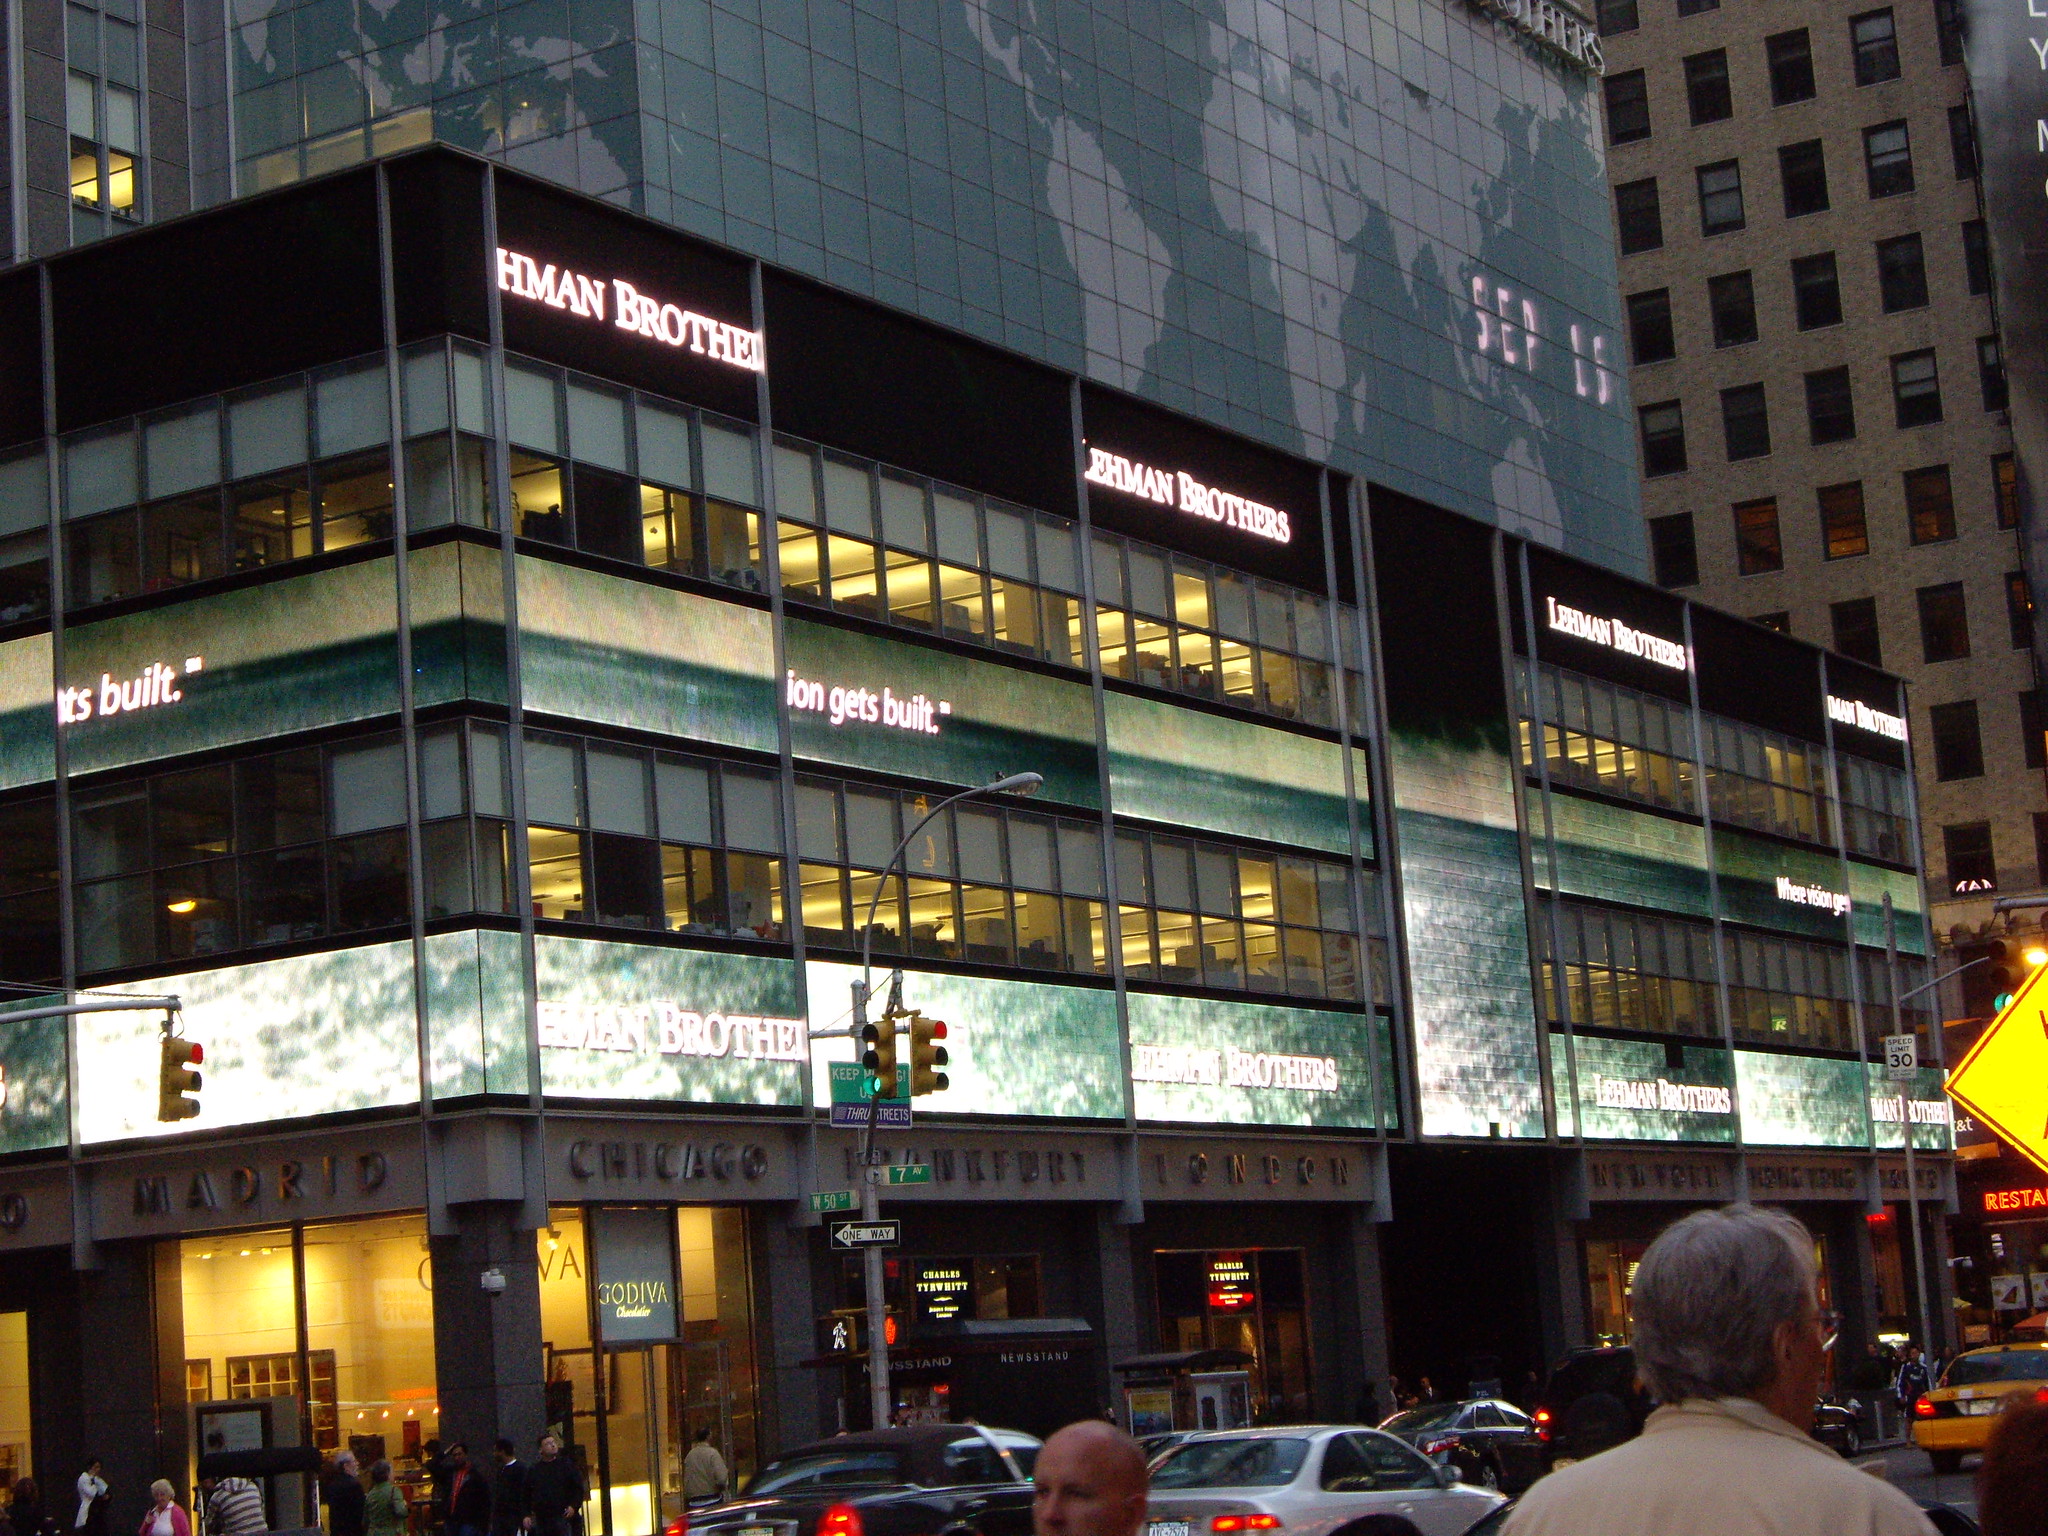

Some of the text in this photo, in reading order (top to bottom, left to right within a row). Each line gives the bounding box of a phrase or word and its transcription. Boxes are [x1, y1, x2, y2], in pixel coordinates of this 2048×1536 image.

[1472, 276, 1536, 371] SEP
[1084, 447, 1291, 543] EHMAN BROTHERS
[1547, 596, 1686, 670] LEHMAN BROTHERS
[99, 662, 182, 716] built.
[786, 669, 824, 711] ion
[829, 687, 878, 725] gets
[883, 687, 939, 734] built.
[1855, 700, 1907, 741] BROTHE
[1776, 876, 1806, 904] Where
[1807, 884, 1832, 909] vision
[1131, 1045, 1338, 1092] EHMAN BROTHERS
[1890, 1053, 1913, 1067] 30
[832, 1068, 860, 1081] KEEP
[1592, 1073, 1732, 1114] LEHMAN BROTHERS
[847, 1107, 909, 1121] THRU TREETS
[568, 1140, 768, 1182] CHICAGO
[1156, 1153, 1348, 1187] LONDON
[132, 1151, 388, 1216] MADRID
[896, 1167, 922, 1182] 7 AV
[812, 1193, 848, 1210] W 50 ST
[1985, 1189, 2048, 1210] RESTA
[842, 1229, 891, 1241] ONE WAY
[923, 1270, 960, 1279] CHARLES
[1214, 1262, 1244, 1270] CHARLES
[598, 1281, 668, 1304] GODIVA
[916, 1282, 968, 1292] TYRWHITT
[862, 1356, 952, 1373] NWSSTAND
[1001, 1351, 1070, 1364] NEWSSTAND
